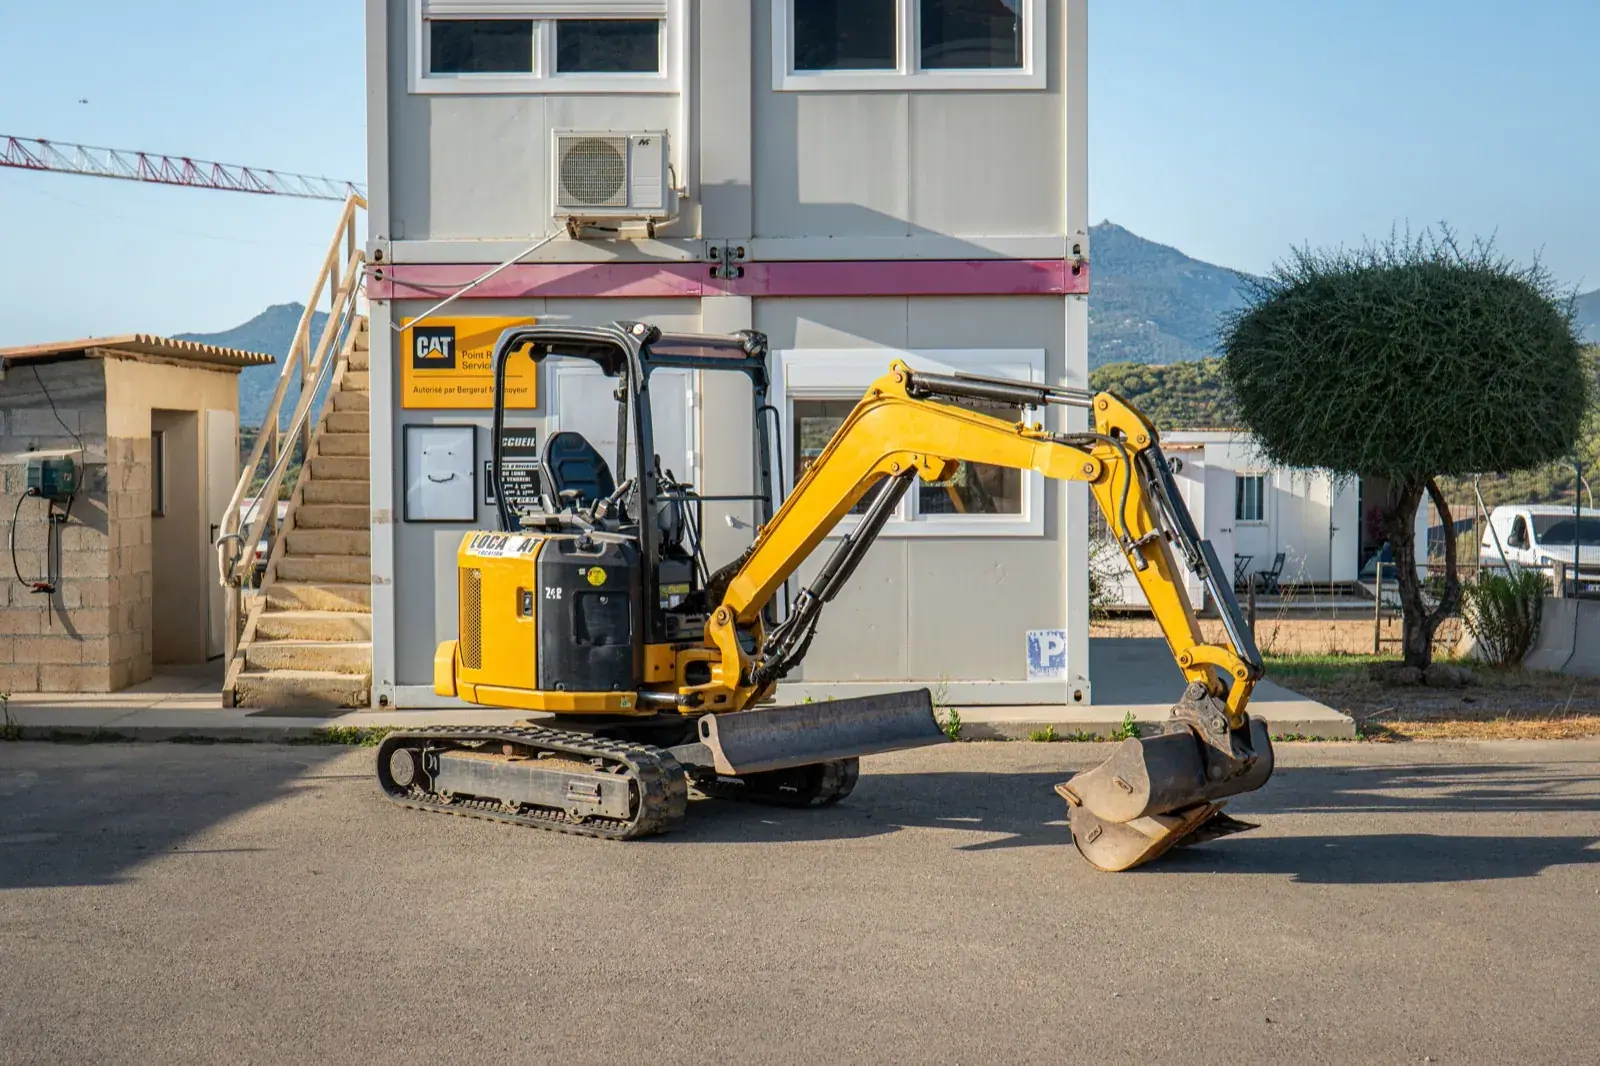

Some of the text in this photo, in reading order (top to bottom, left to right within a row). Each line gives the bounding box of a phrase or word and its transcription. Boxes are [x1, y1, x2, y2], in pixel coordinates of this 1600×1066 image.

[416, 336, 452, 358] CAT
[462, 350, 484, 360] Point
[462, 361, 492, 370] Servic
[412, 385, 443, 394] Autorisé
[444, 386, 455, 395] par
[457, 385, 488, 395] Bergerat
[502, 437, 536, 447] CCUEIL
[1040, 635, 1065, 667] P
